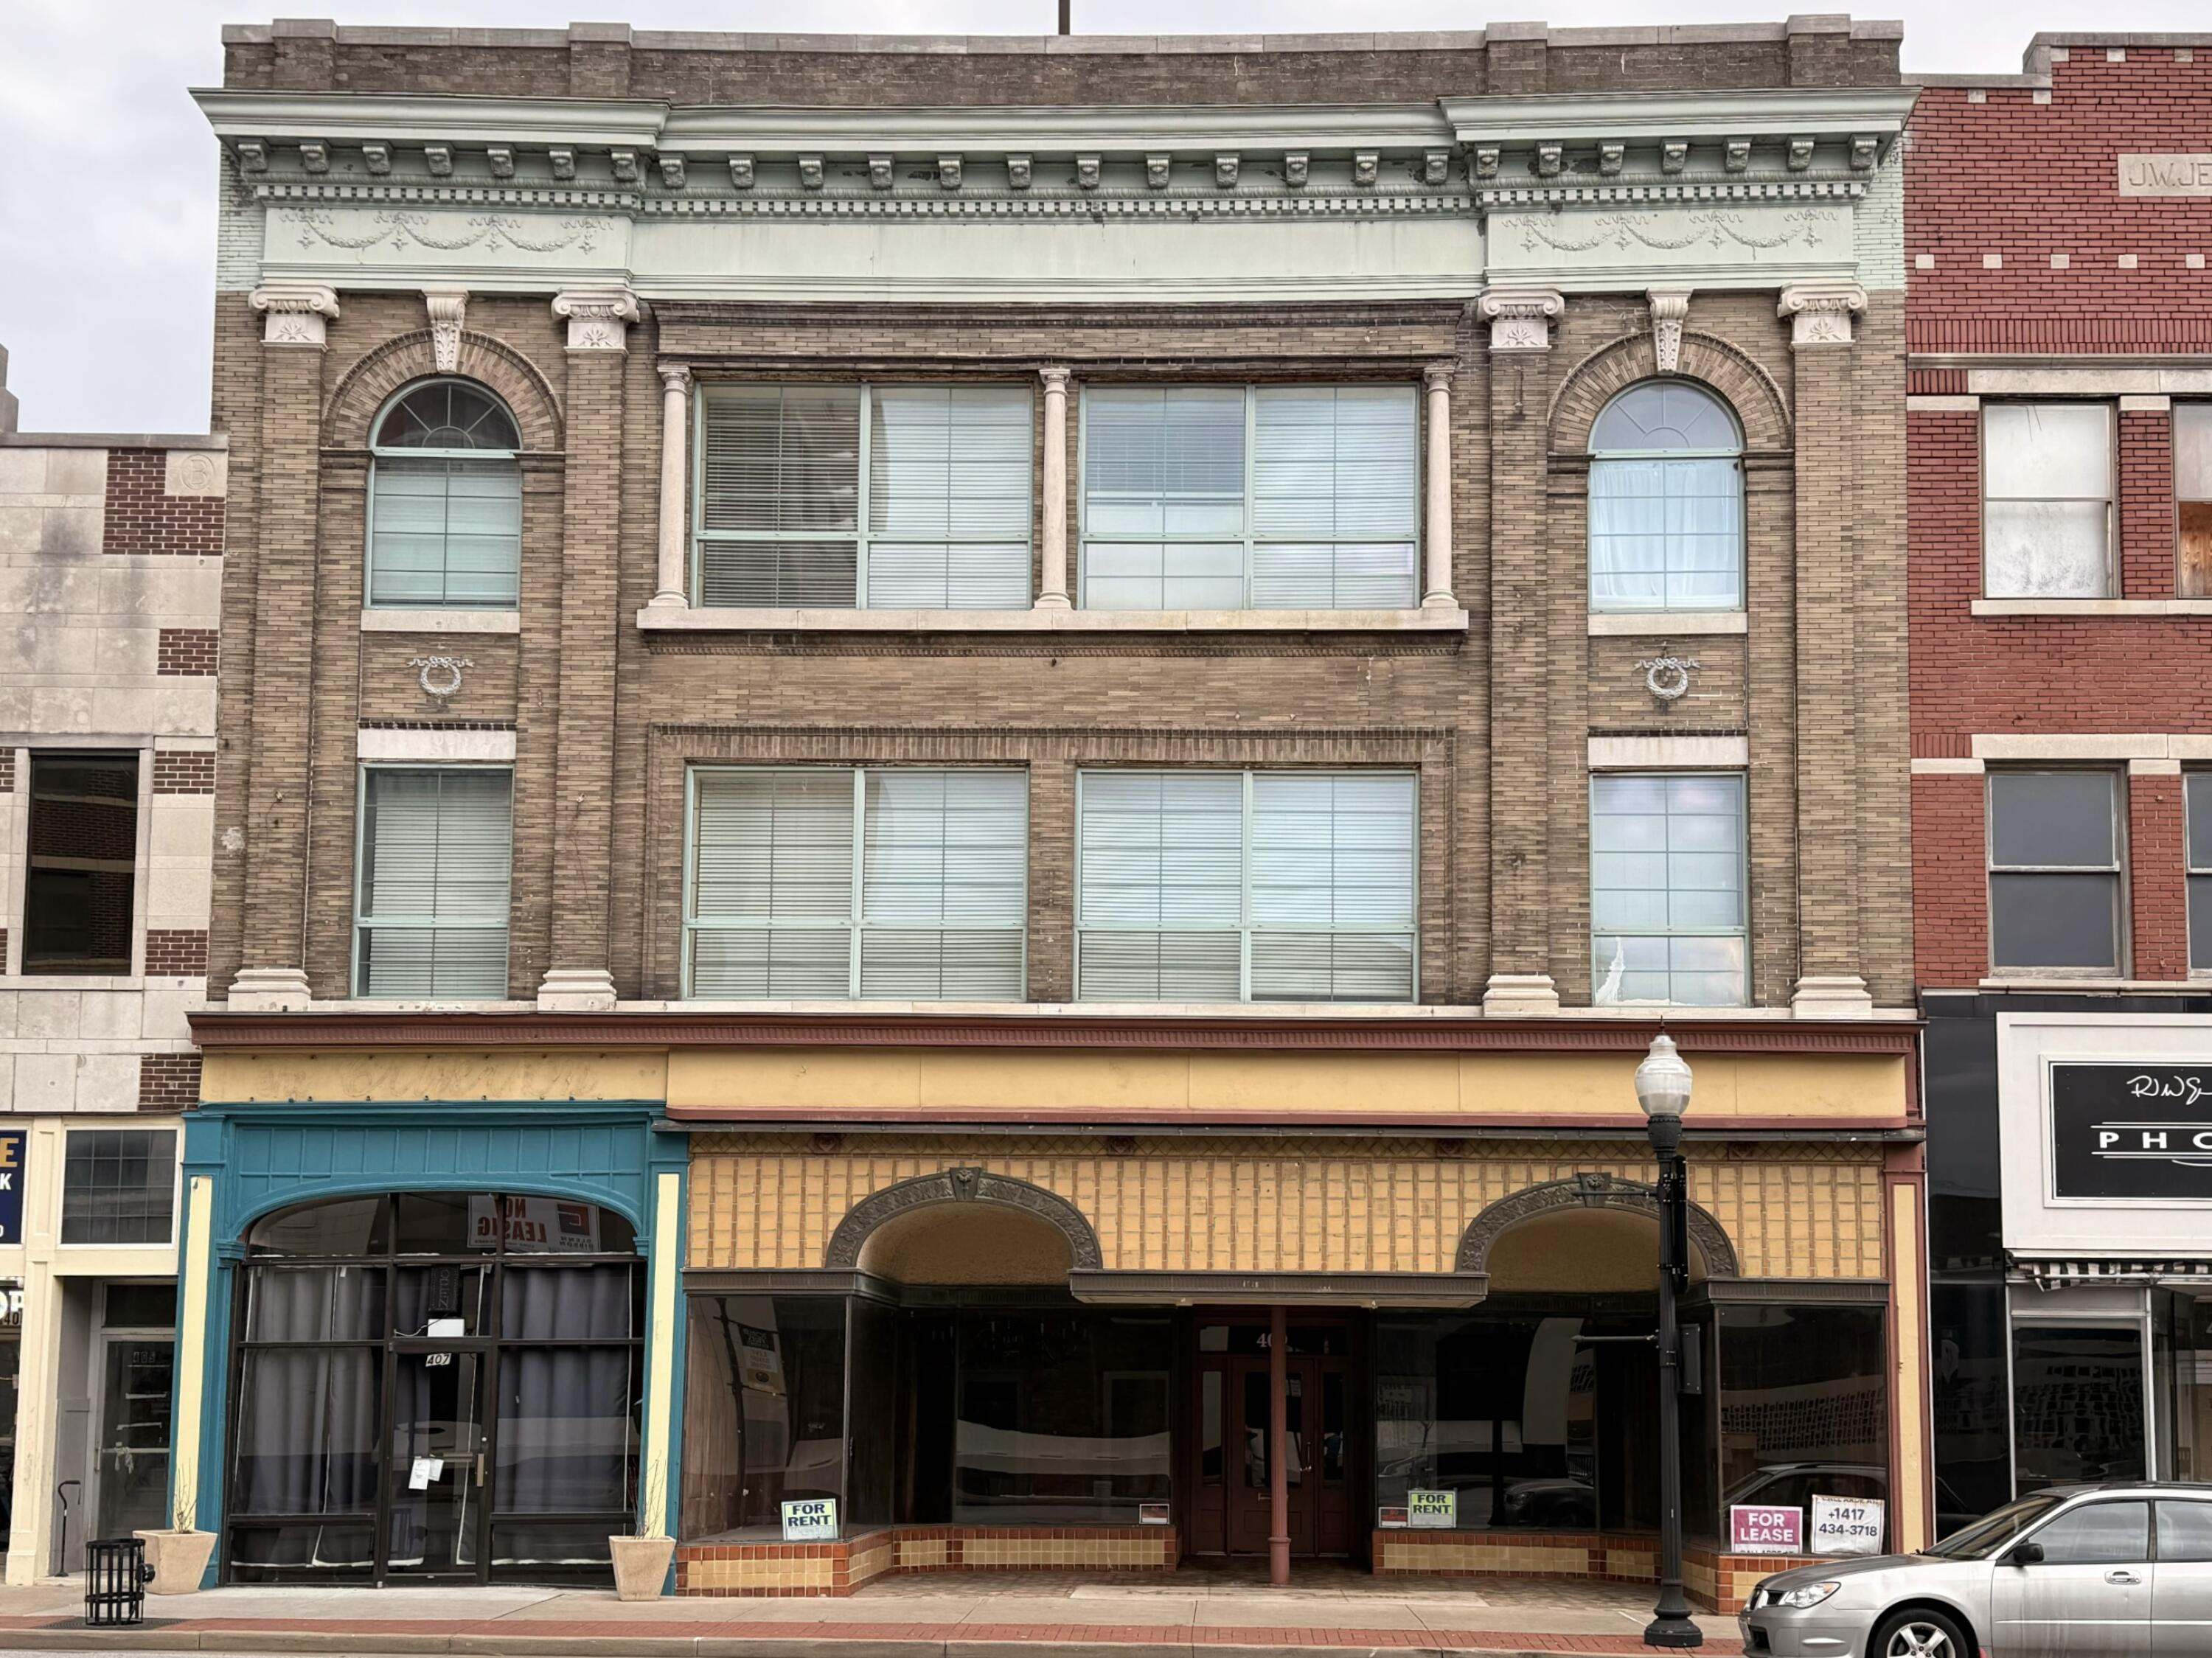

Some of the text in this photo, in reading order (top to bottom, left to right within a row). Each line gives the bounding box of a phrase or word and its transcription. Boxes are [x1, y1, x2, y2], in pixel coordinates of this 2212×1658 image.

[4, 1312, 20, 1325] 40
[427, 1354, 450, 1365] 407
[1416, 1494, 1447, 1504] FOR
[792, 1504, 825, 1515] FOR
[1413, 1505, 1452, 1514] RENT
[1829, 1508, 1865, 1521] +1417
[787, 1515, 831, 1527] RENT
[1748, 1513, 1785, 1527] FOR
[1740, 1528, 1794, 1542] LEASE
[1819, 1523, 1877, 1536] 434-3718
